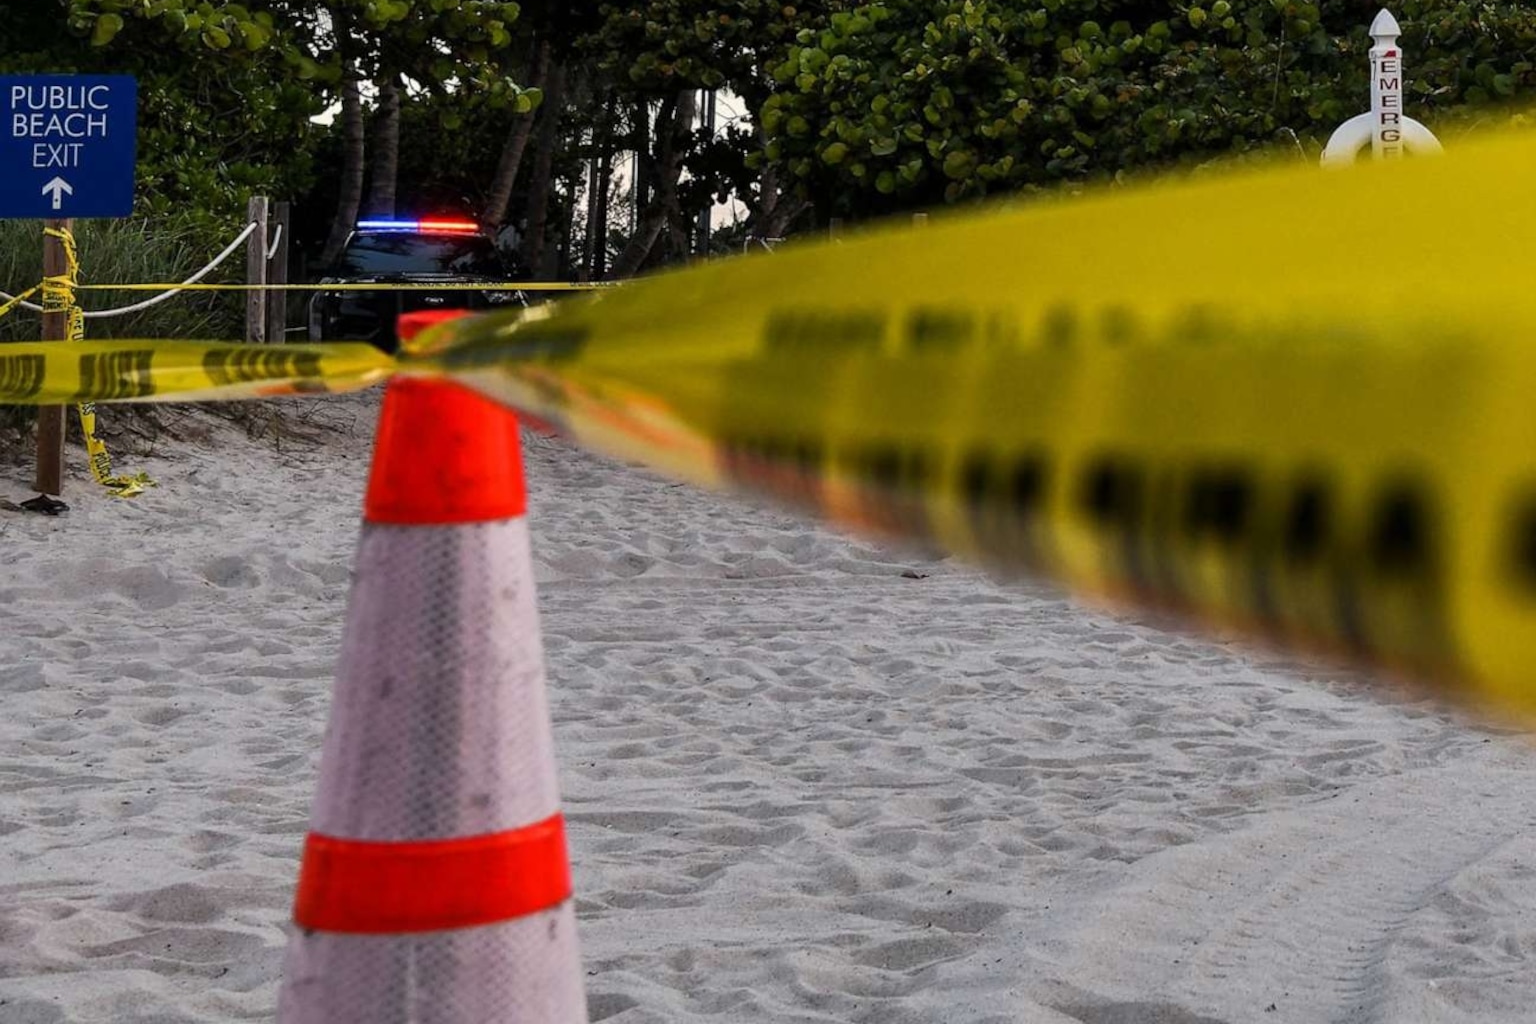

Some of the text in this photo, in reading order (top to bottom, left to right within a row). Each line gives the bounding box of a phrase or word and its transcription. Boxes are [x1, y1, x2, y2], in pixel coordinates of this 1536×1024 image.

[11, 85, 110, 110] PUBLIC
[13, 113, 106, 137] BEACH
[32, 143, 84, 167] EXIT
